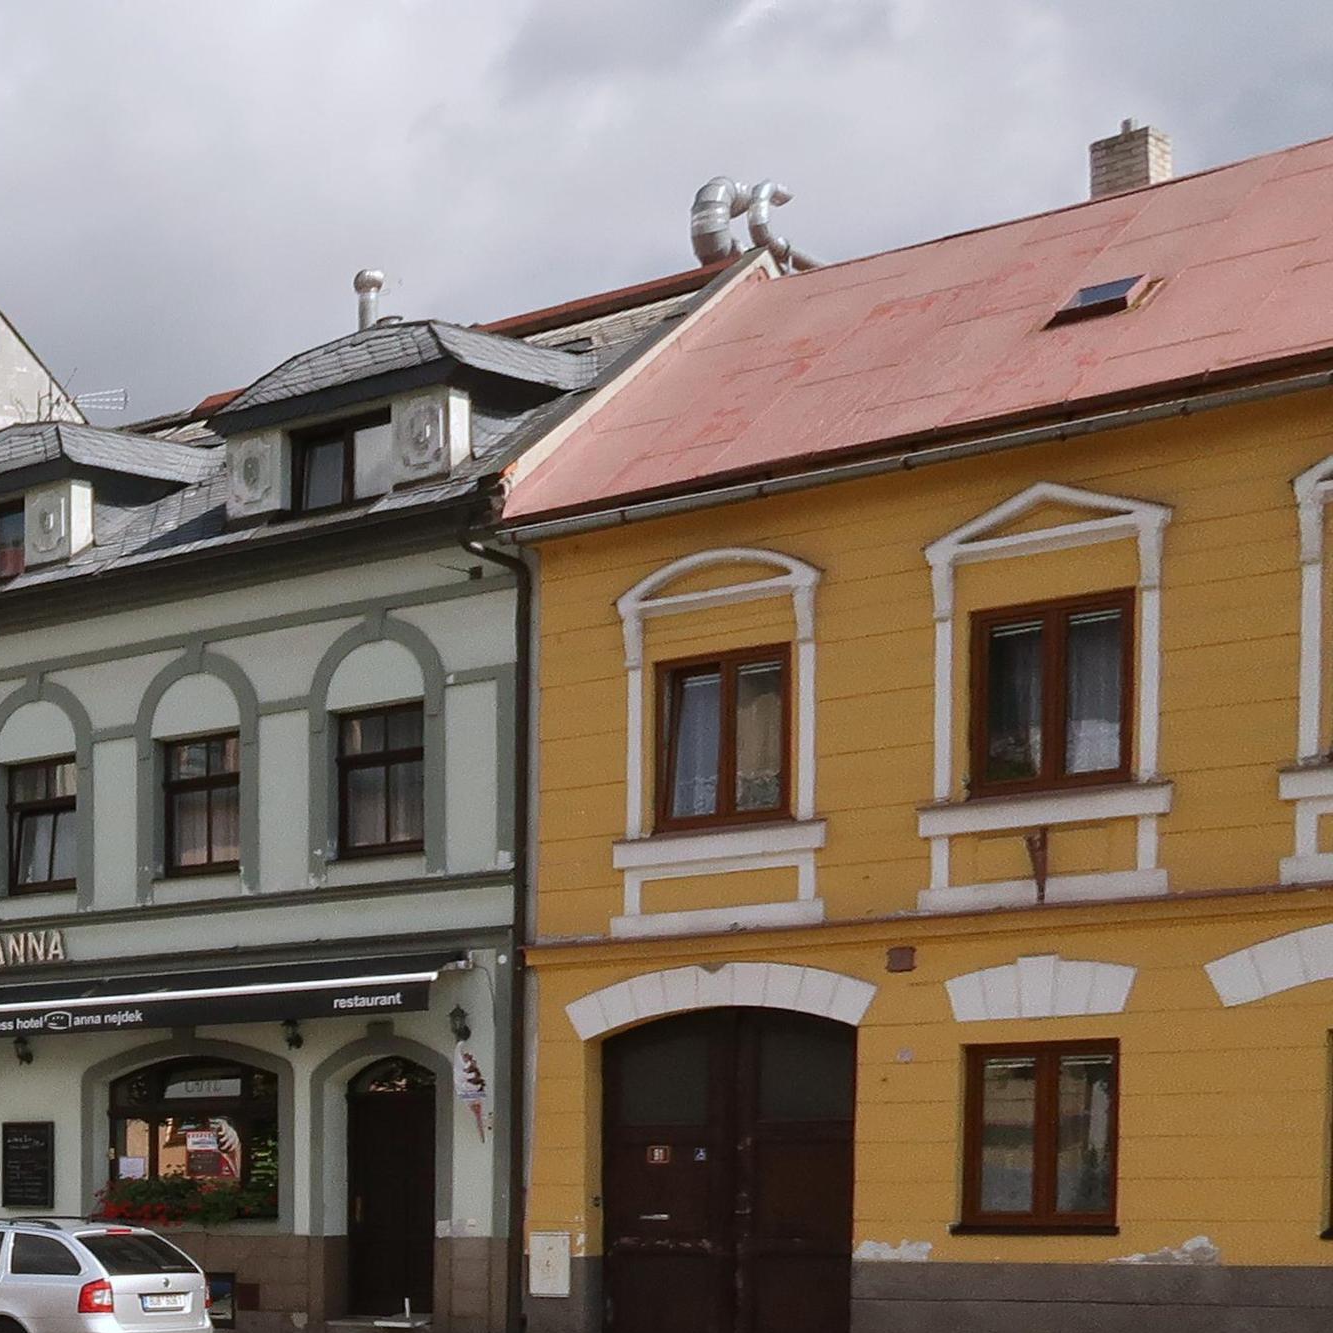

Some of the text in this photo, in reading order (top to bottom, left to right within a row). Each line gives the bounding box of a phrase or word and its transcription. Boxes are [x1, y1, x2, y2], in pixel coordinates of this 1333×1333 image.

[333, 992, 404, 1009] restaurant
[15, 1015, 45, 1030] hotel
[73, 1014, 102, 1026] anna
[104, 1009, 144, 1026] nejdek
